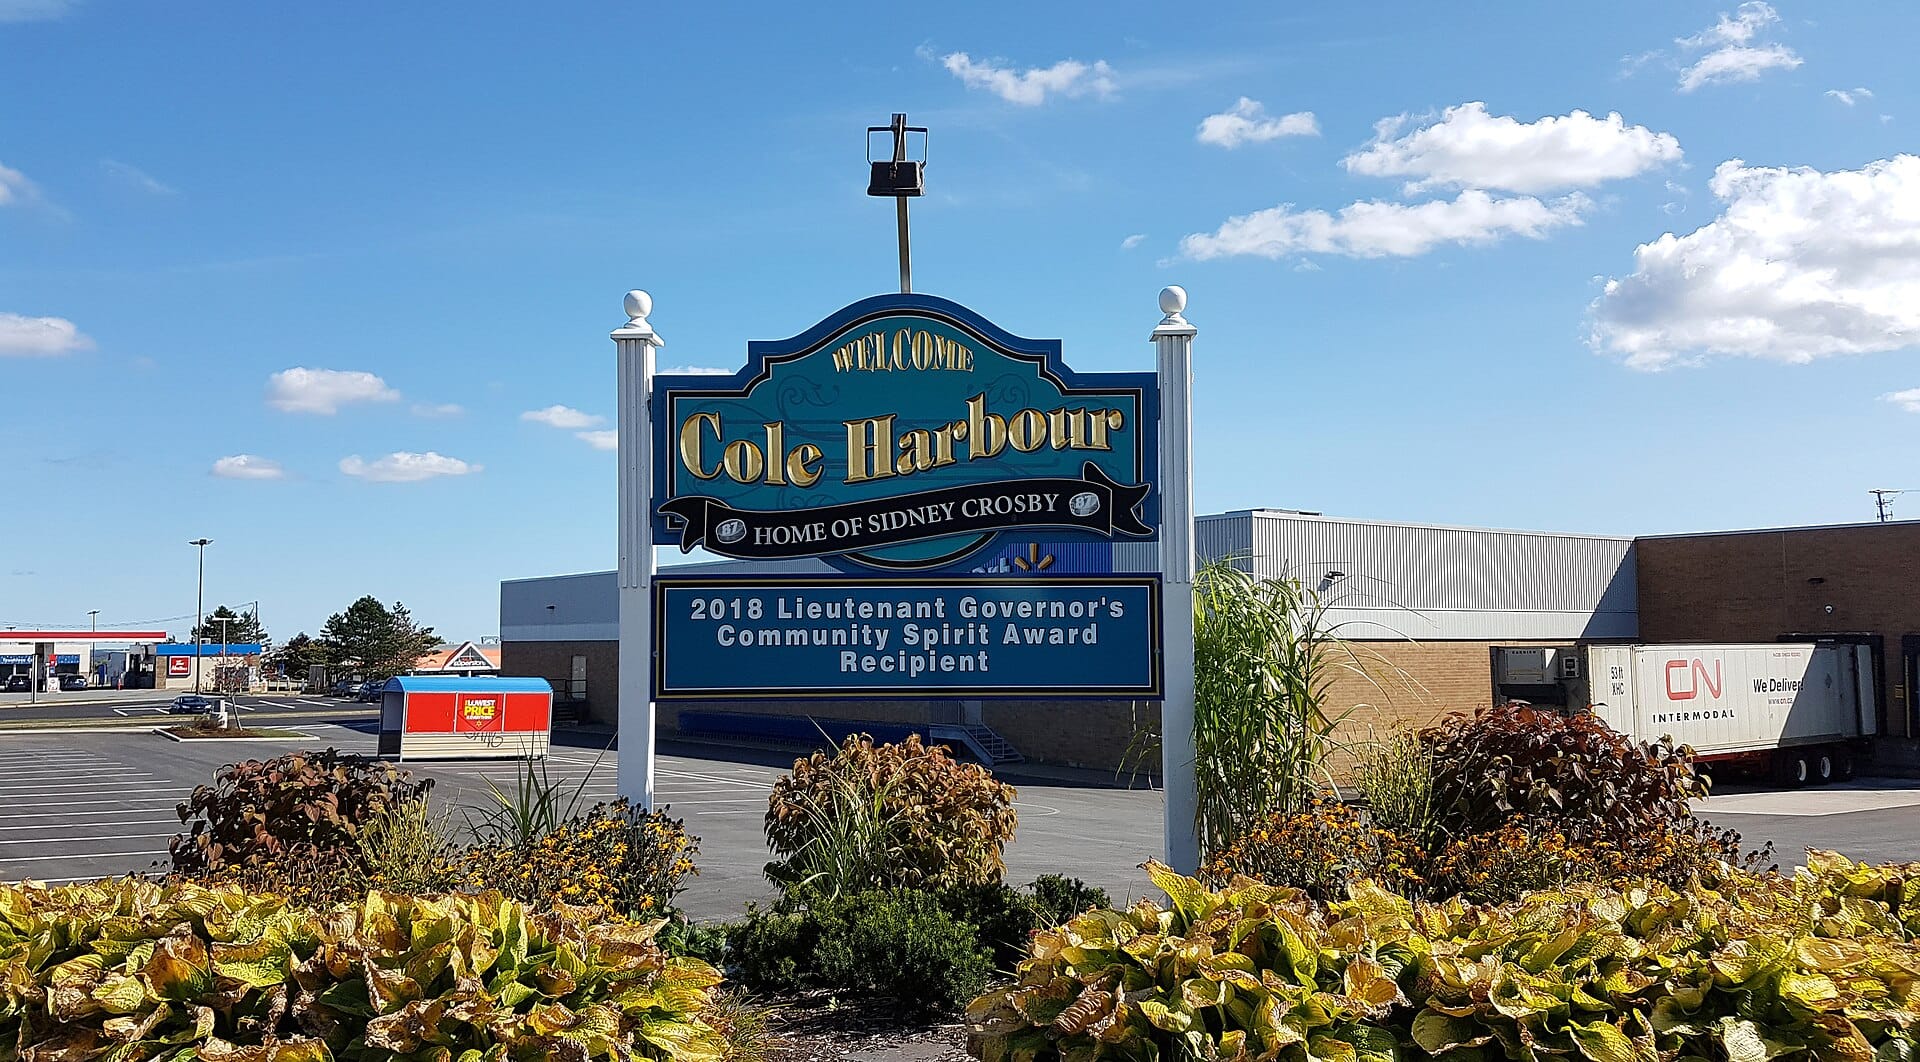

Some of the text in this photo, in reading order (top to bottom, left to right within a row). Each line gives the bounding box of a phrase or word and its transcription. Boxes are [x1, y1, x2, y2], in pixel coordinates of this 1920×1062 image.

[832, 327, 974, 372] WELCOME
[680, 392, 1123, 487] Cole Harbour
[753, 494, 1059, 545] HOME OF SIDNEY CROSBY
[691, 597, 1124, 619] 2018 Lieutenant Governor's
[717, 623, 1097, 651] Community Spirit Award
[840, 650, 988, 677] Recipient
[1611, 667, 1618, 679] 53
[1665, 658, 1721, 700] CN
[1753, 678, 1804, 693] We Deliver!
[464, 706, 495, 716] PRICE
[1653, 709, 1735, 723] INTERMODAL
